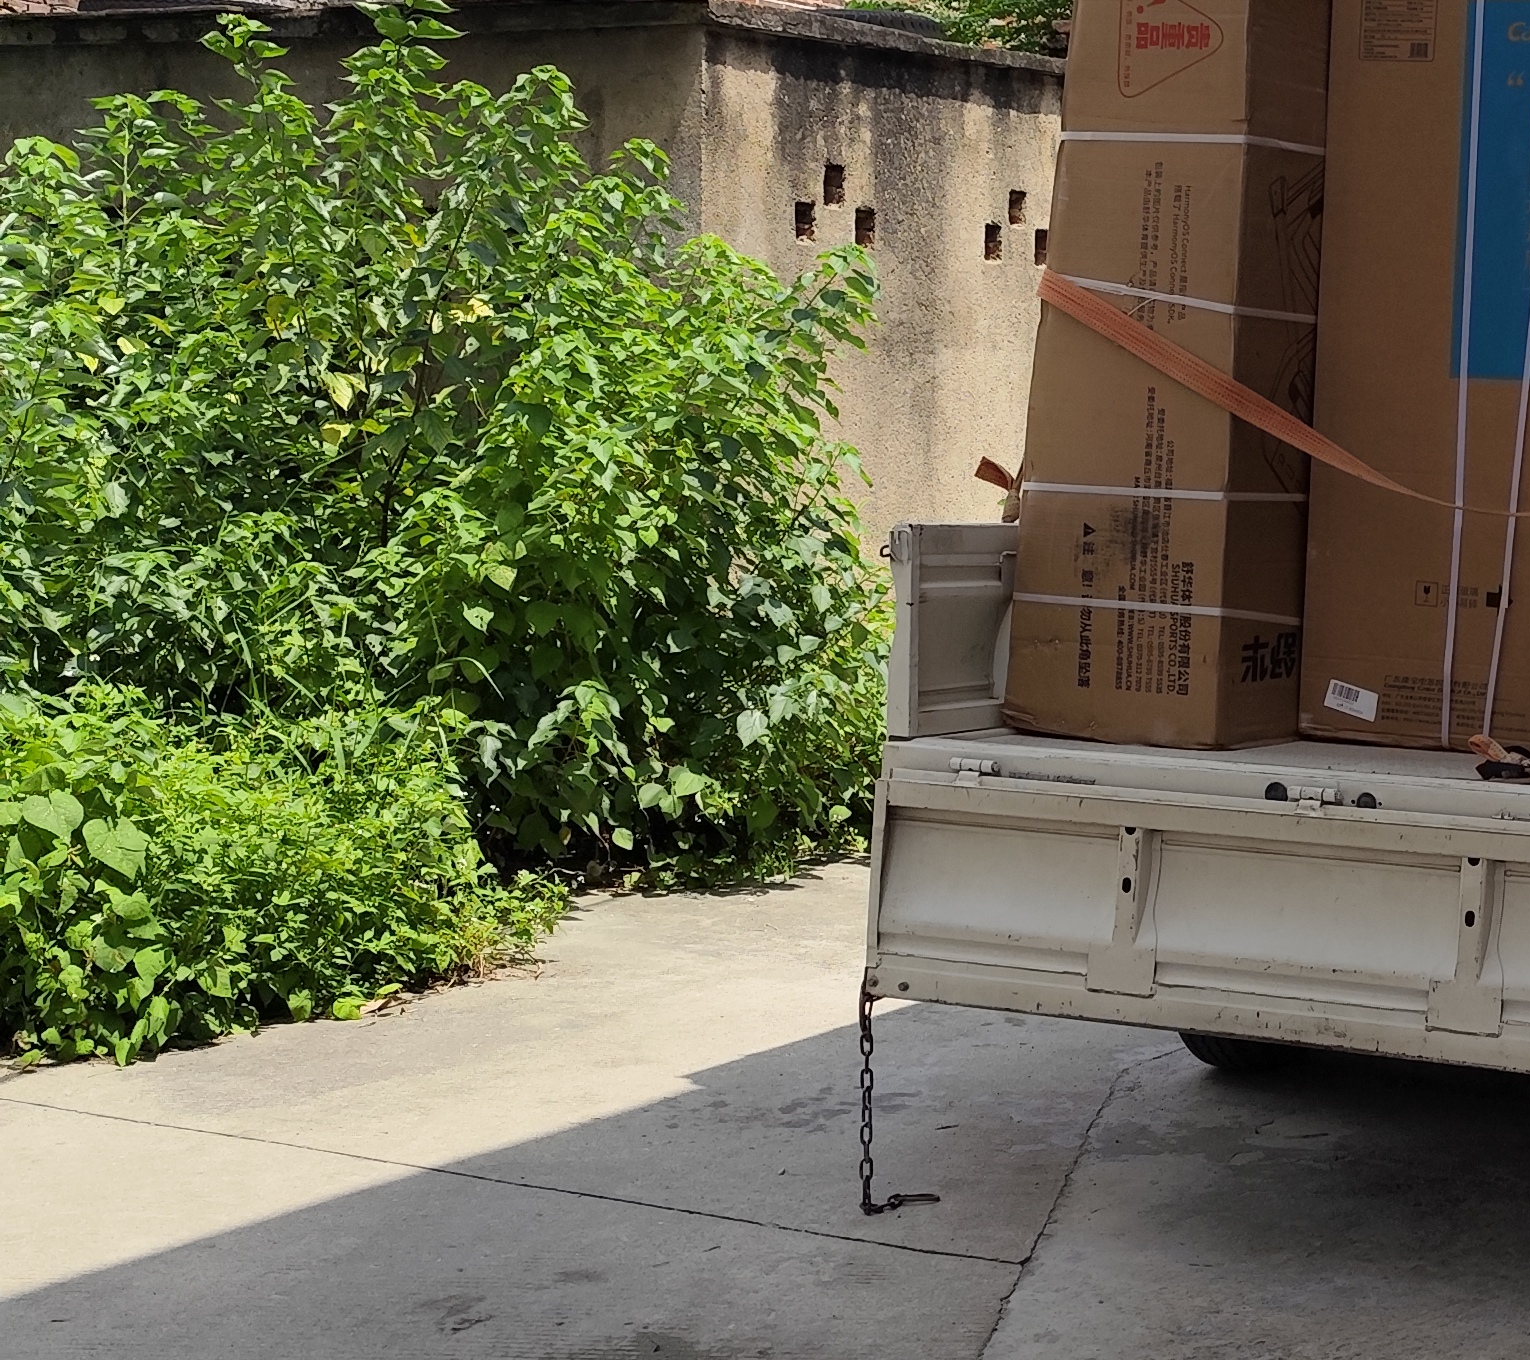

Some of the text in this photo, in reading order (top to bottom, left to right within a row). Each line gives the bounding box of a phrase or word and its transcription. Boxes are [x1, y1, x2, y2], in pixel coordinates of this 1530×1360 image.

[1135, 21, 1211, 50] 贵重品
[1180, 185, 1192, 236] HarmonyOS
[1170, 213, 1181, 265] HarmonyOS
[1180, 238, 1189, 273] Connect
[1077, 541, 1095, 689] 注意!勿从此角坠落
